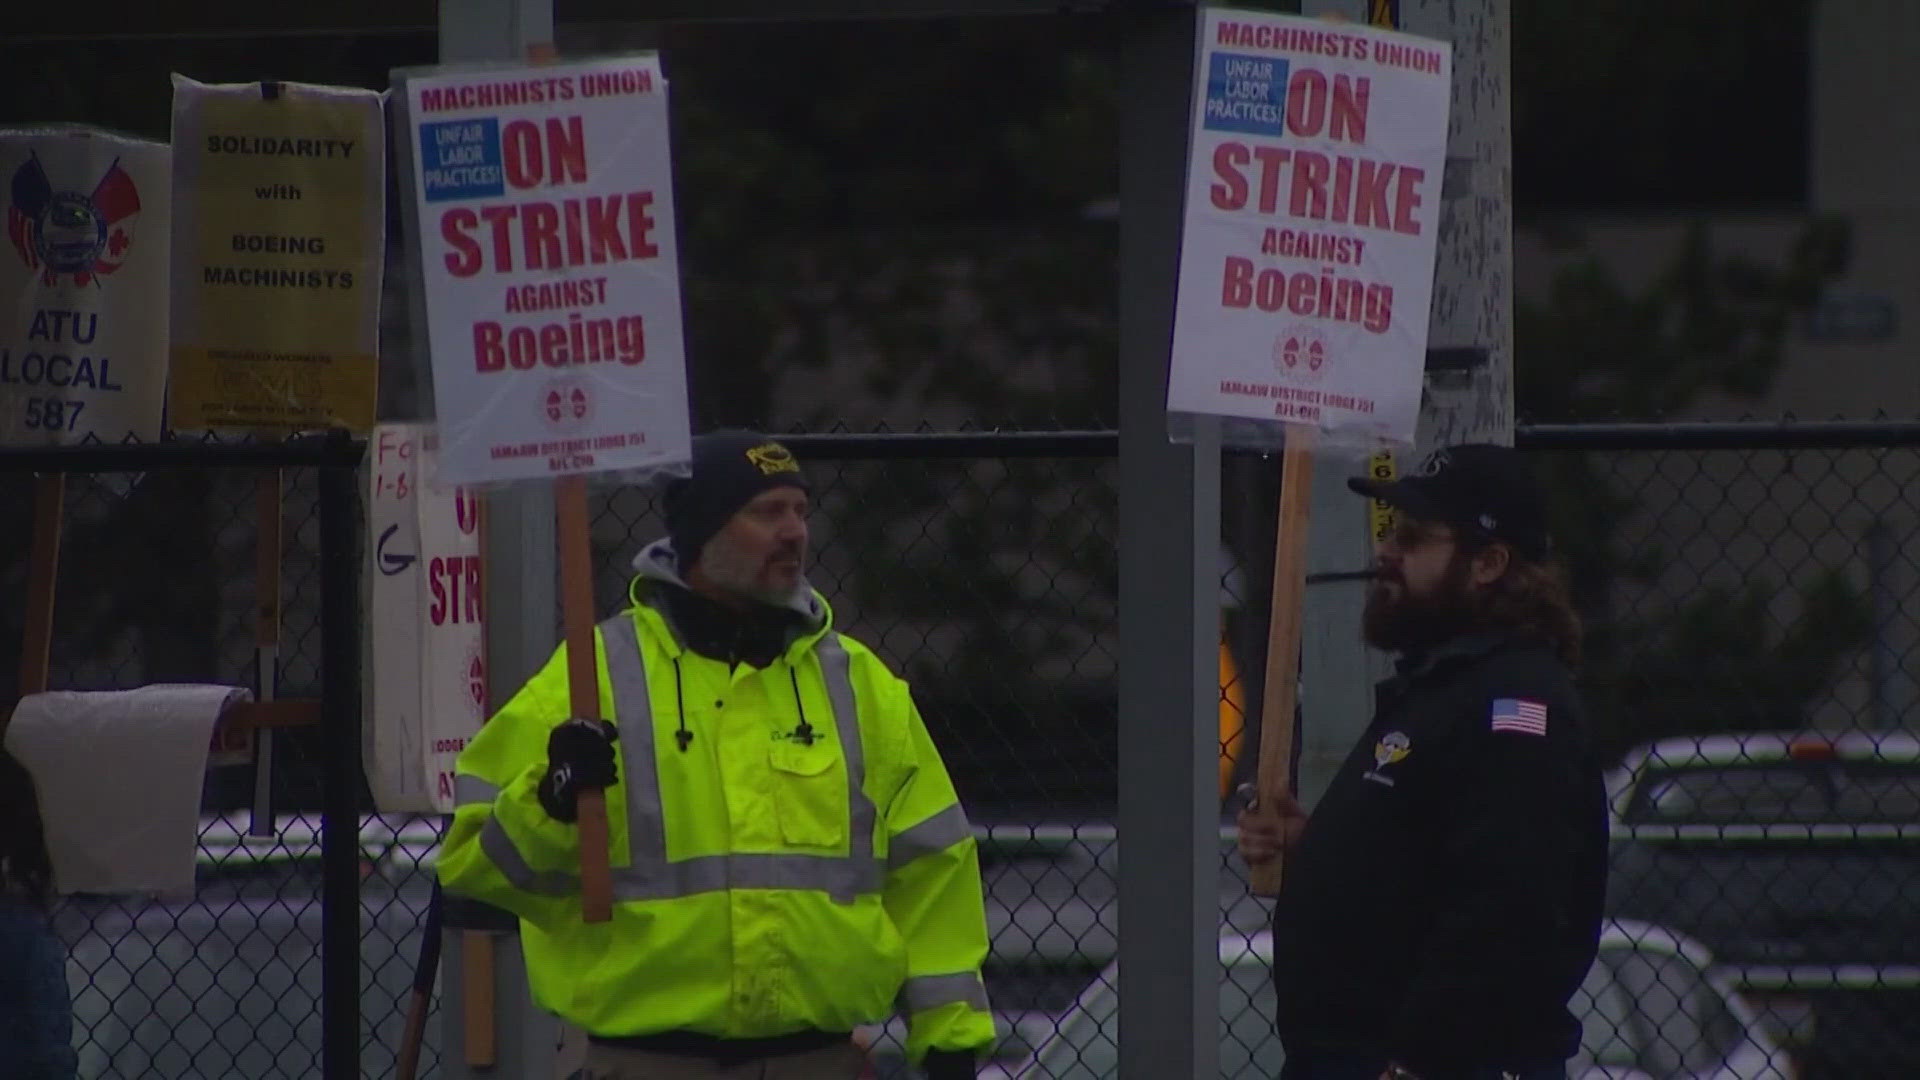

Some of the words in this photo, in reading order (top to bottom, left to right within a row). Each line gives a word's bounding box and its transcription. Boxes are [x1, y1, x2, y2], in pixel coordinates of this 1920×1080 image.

[1217, 21, 1368, 60] MACHINISTS
[1374, 41, 1441, 74] UNION
[1225, 60, 1273, 79] UNFAIR
[421, 77, 574, 112] MACHINISTS
[581, 69, 652, 97] UNION
[1225, 79, 1269, 99] LABOR
[1207, 100, 1283, 124] PRACTICES!
[1286, 68, 1371, 144] ON
[208, 135, 354, 159] SOLIDARITY
[435, 125, 483, 145] UNFAIR
[439, 144, 484, 165] LABOR
[502, 116, 587, 189] ON
[255, 184, 301, 201] with
[425, 165, 500, 188] PRACTICES!
[1210, 142, 1425, 236] STRIKE
[232, 235, 324, 254] BOEING
[441, 191, 658, 278] STRIKE
[1261, 227, 1365, 267] AGAINST
[204, 267, 353, 289] MACHINISTS
[505, 277, 607, 313] AGAINST
[1222, 256, 1393, 334] Boeing
[29, 310, 97, 344] ATU
[473, 314, 644, 373] Boeing
[1, 351, 122, 391] LOCAL
[25, 399, 85, 431] 587
[1271, 386, 1320, 404] DISTRICT
[1323, 393, 1355, 409] LODGE
[1358, 397, 1375, 414] 751
[541, 438, 592, 454] DISTRICT
